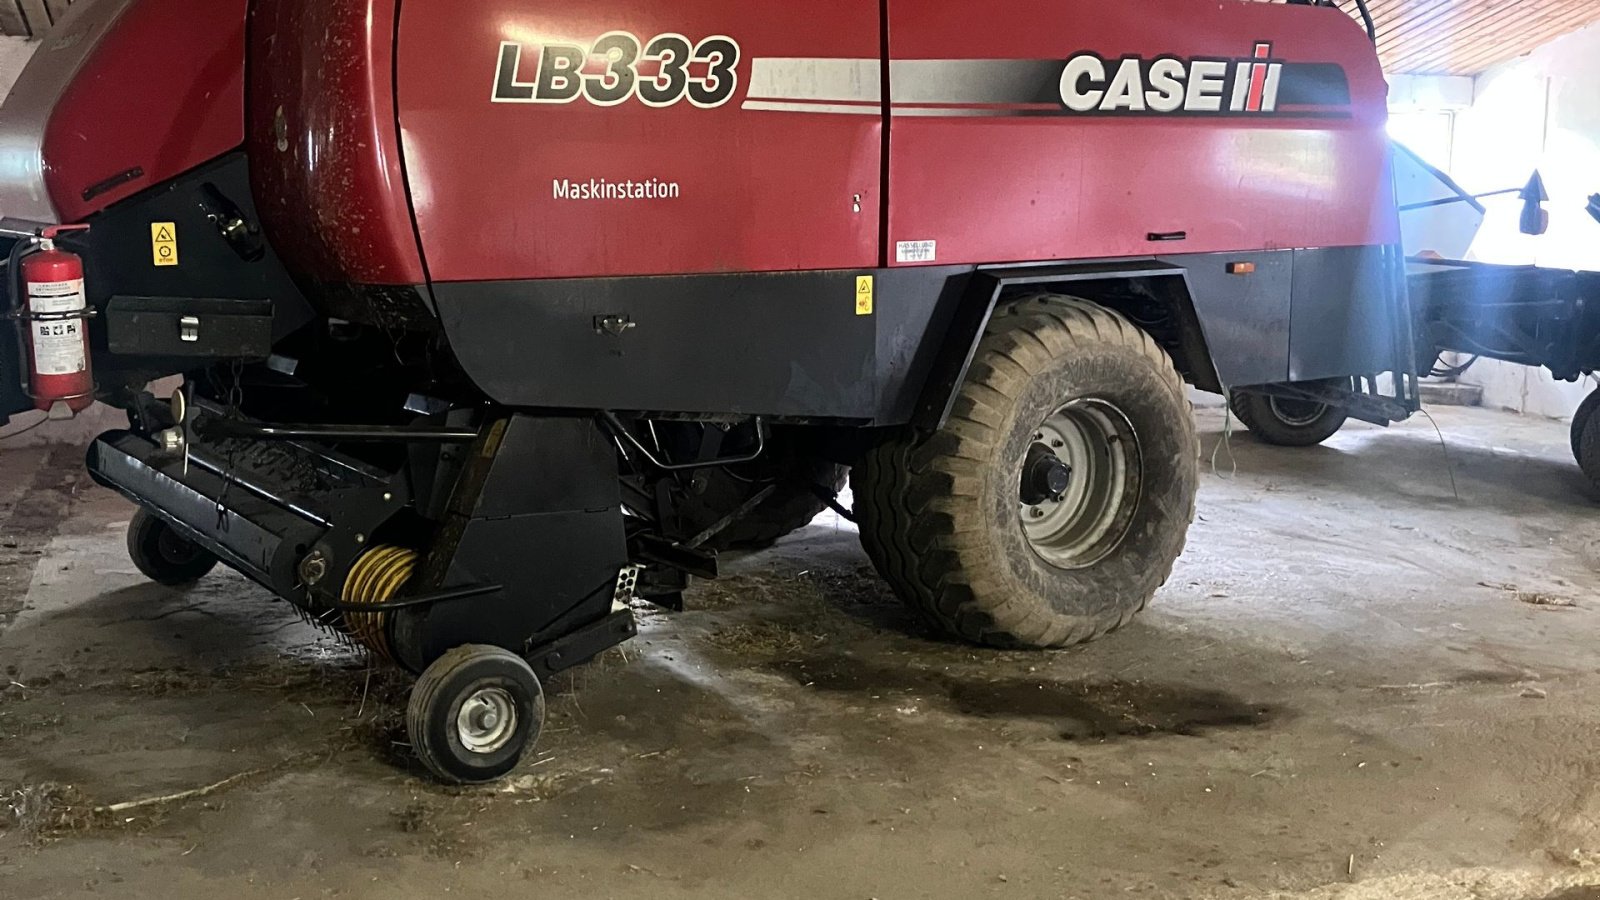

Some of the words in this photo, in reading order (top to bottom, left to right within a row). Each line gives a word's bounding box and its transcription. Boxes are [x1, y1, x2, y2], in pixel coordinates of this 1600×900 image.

[491, 31, 741, 108] LB333
[1059, 55, 1227, 112] CASE
[552, 178, 680, 200] Maskinstation
